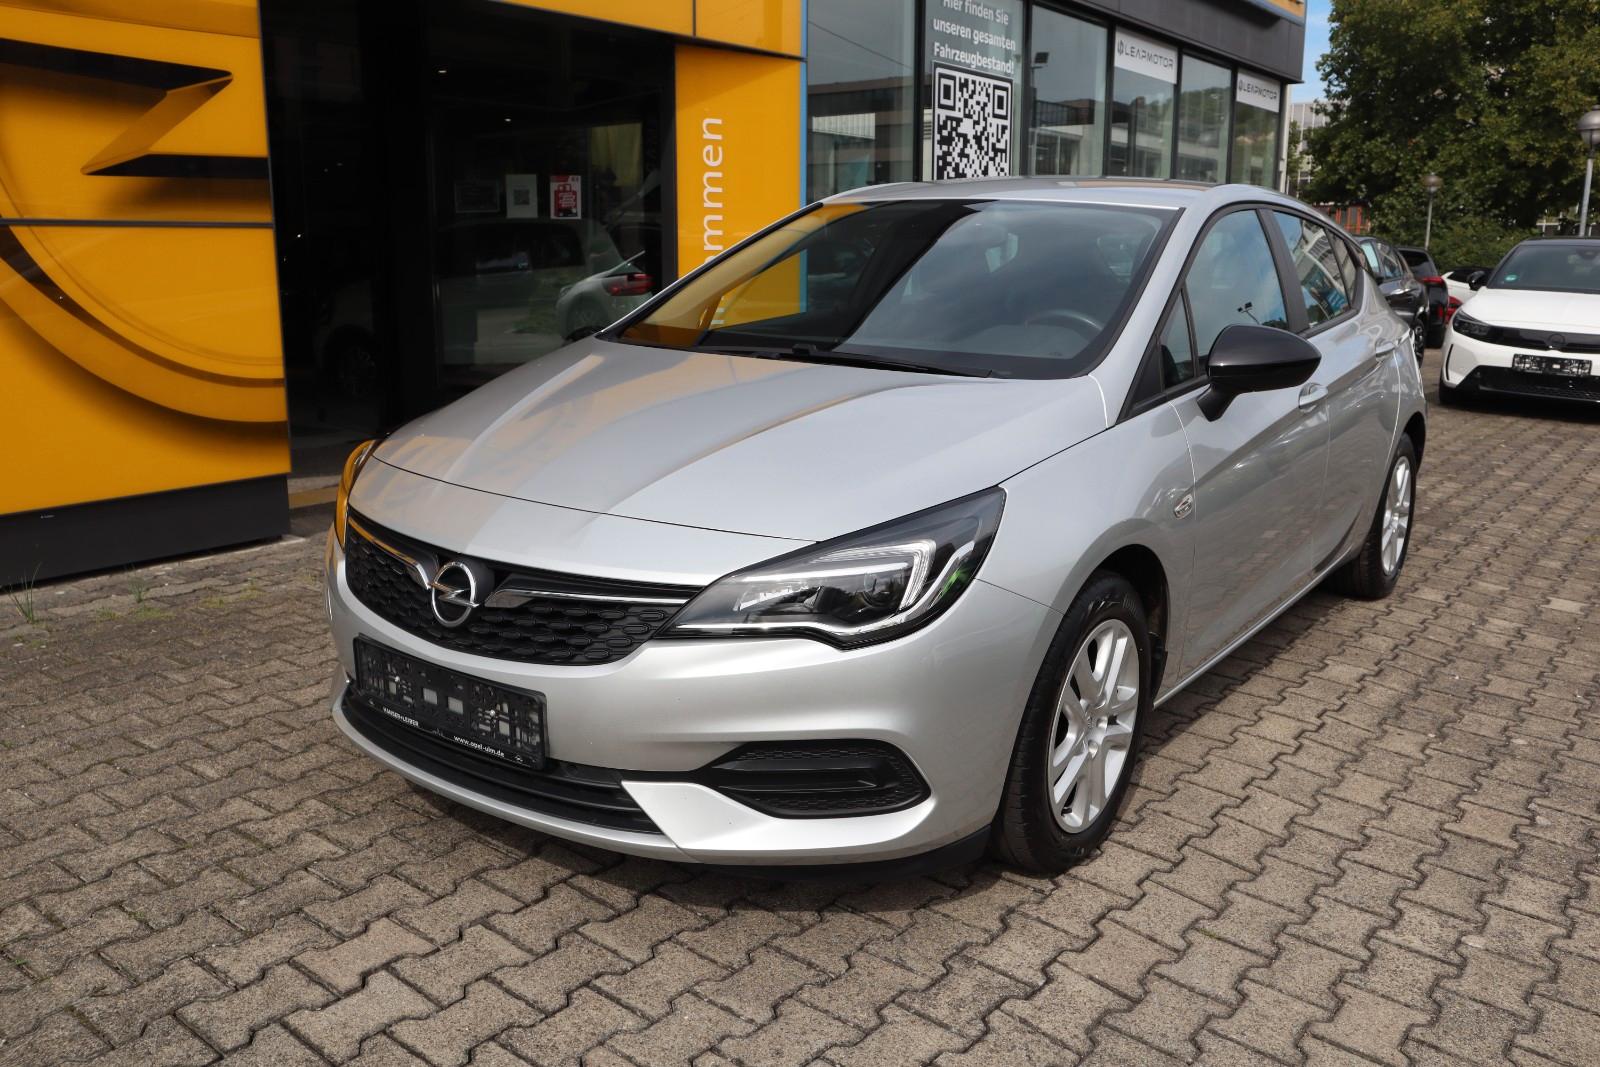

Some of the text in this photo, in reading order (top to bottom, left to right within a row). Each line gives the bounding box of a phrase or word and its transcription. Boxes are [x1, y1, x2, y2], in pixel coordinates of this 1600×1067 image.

[964, 0, 993, 21] finden
[995, 8, 1009, 25] Sie
[933, 18, 1016, 51] unseren gesamten
[933, 41, 1014, 74] Fahrzeugbestand!
[1124, 44, 1174, 70] LEAPMOTOR
